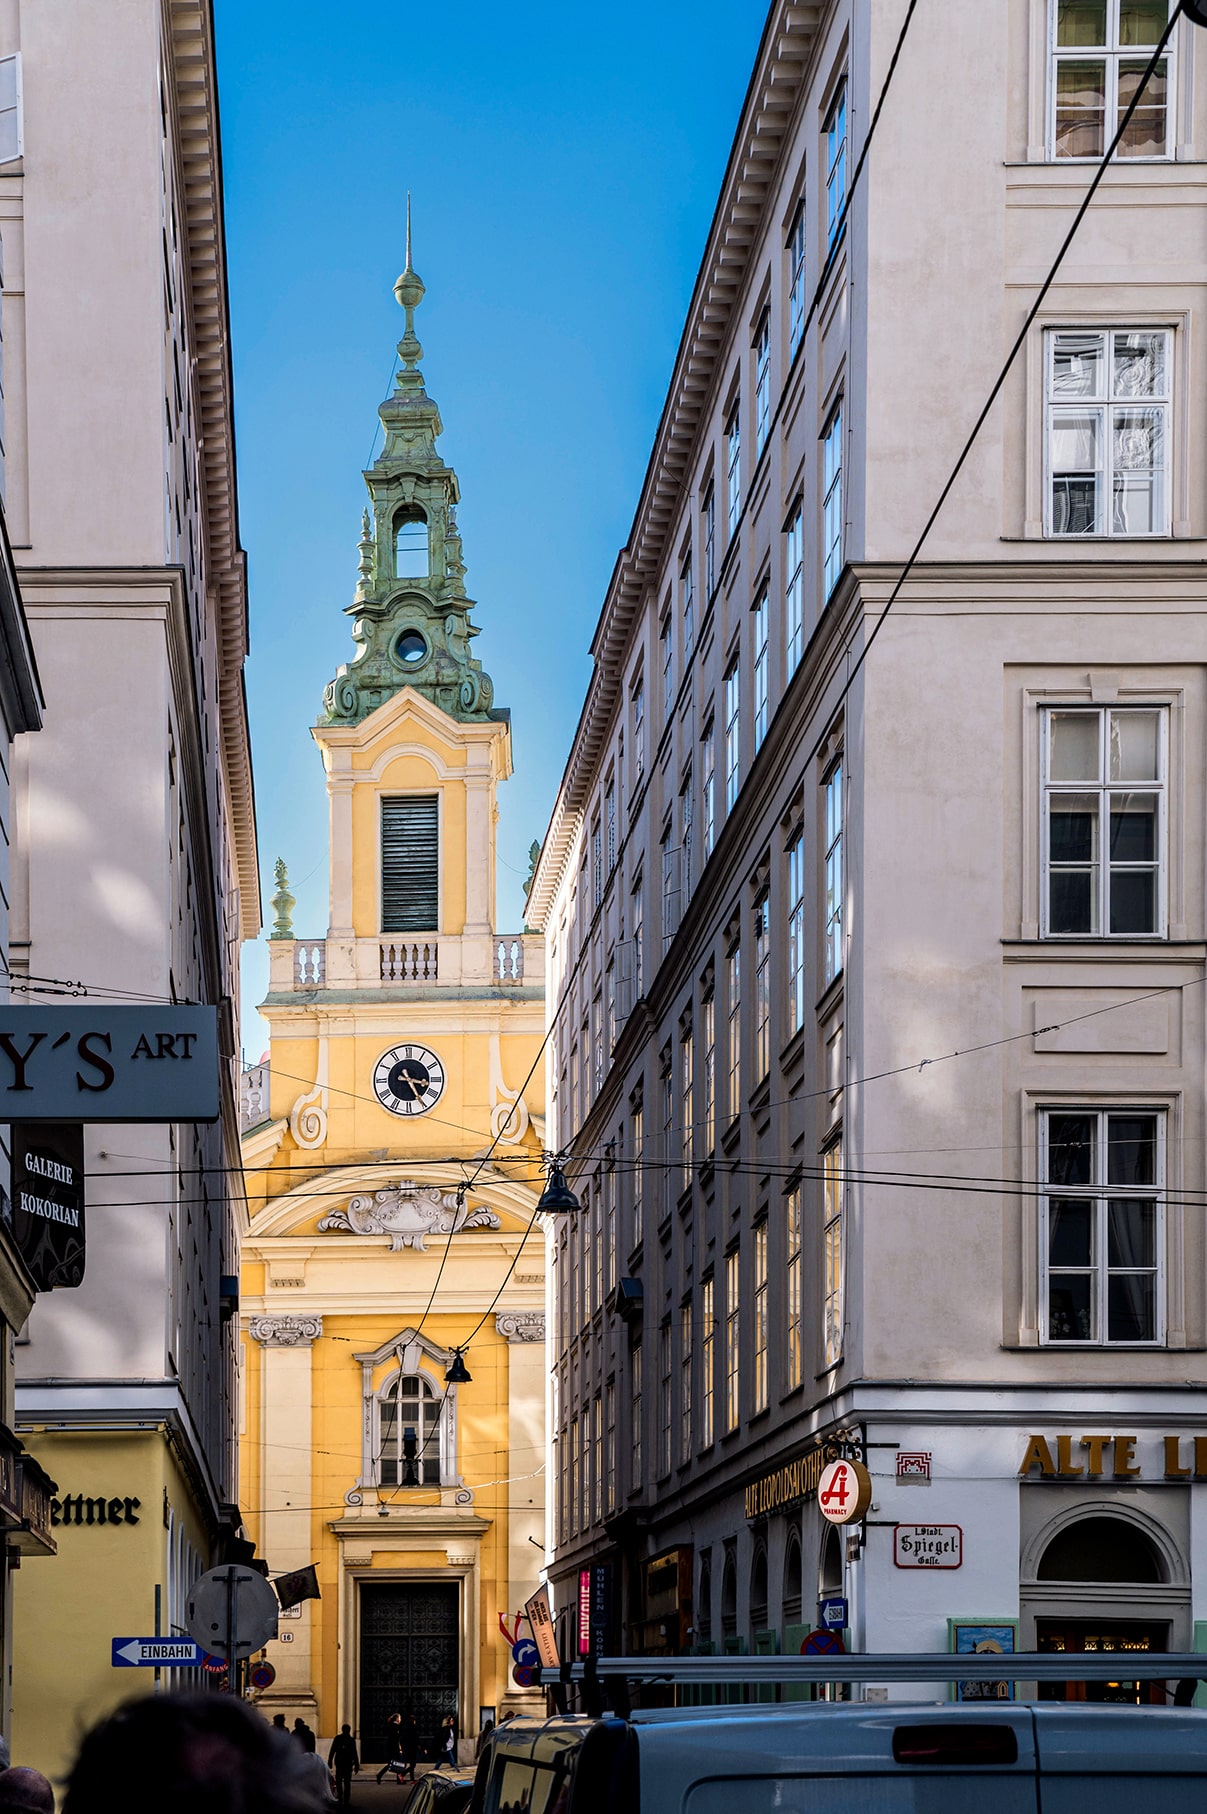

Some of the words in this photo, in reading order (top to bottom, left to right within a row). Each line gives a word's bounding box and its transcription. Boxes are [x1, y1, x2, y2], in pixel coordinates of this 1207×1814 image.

[131, 1033, 198, 1060] ART
[25, 1152, 73, 1185] GALERIE
[20, 1192, 80, 1228] KOKORIAN
[1018, 1434, 1141, 1476] ALTE
[745, 1483, 759, 1519] ALTE
[823, 1507, 848, 1516] PHARMACY
[596, 1568, 605, 1610] MÜHLEN
[141, 1646, 193, 1659] EINBAHN
[204, 1663, 229, 1673] ANFANG
